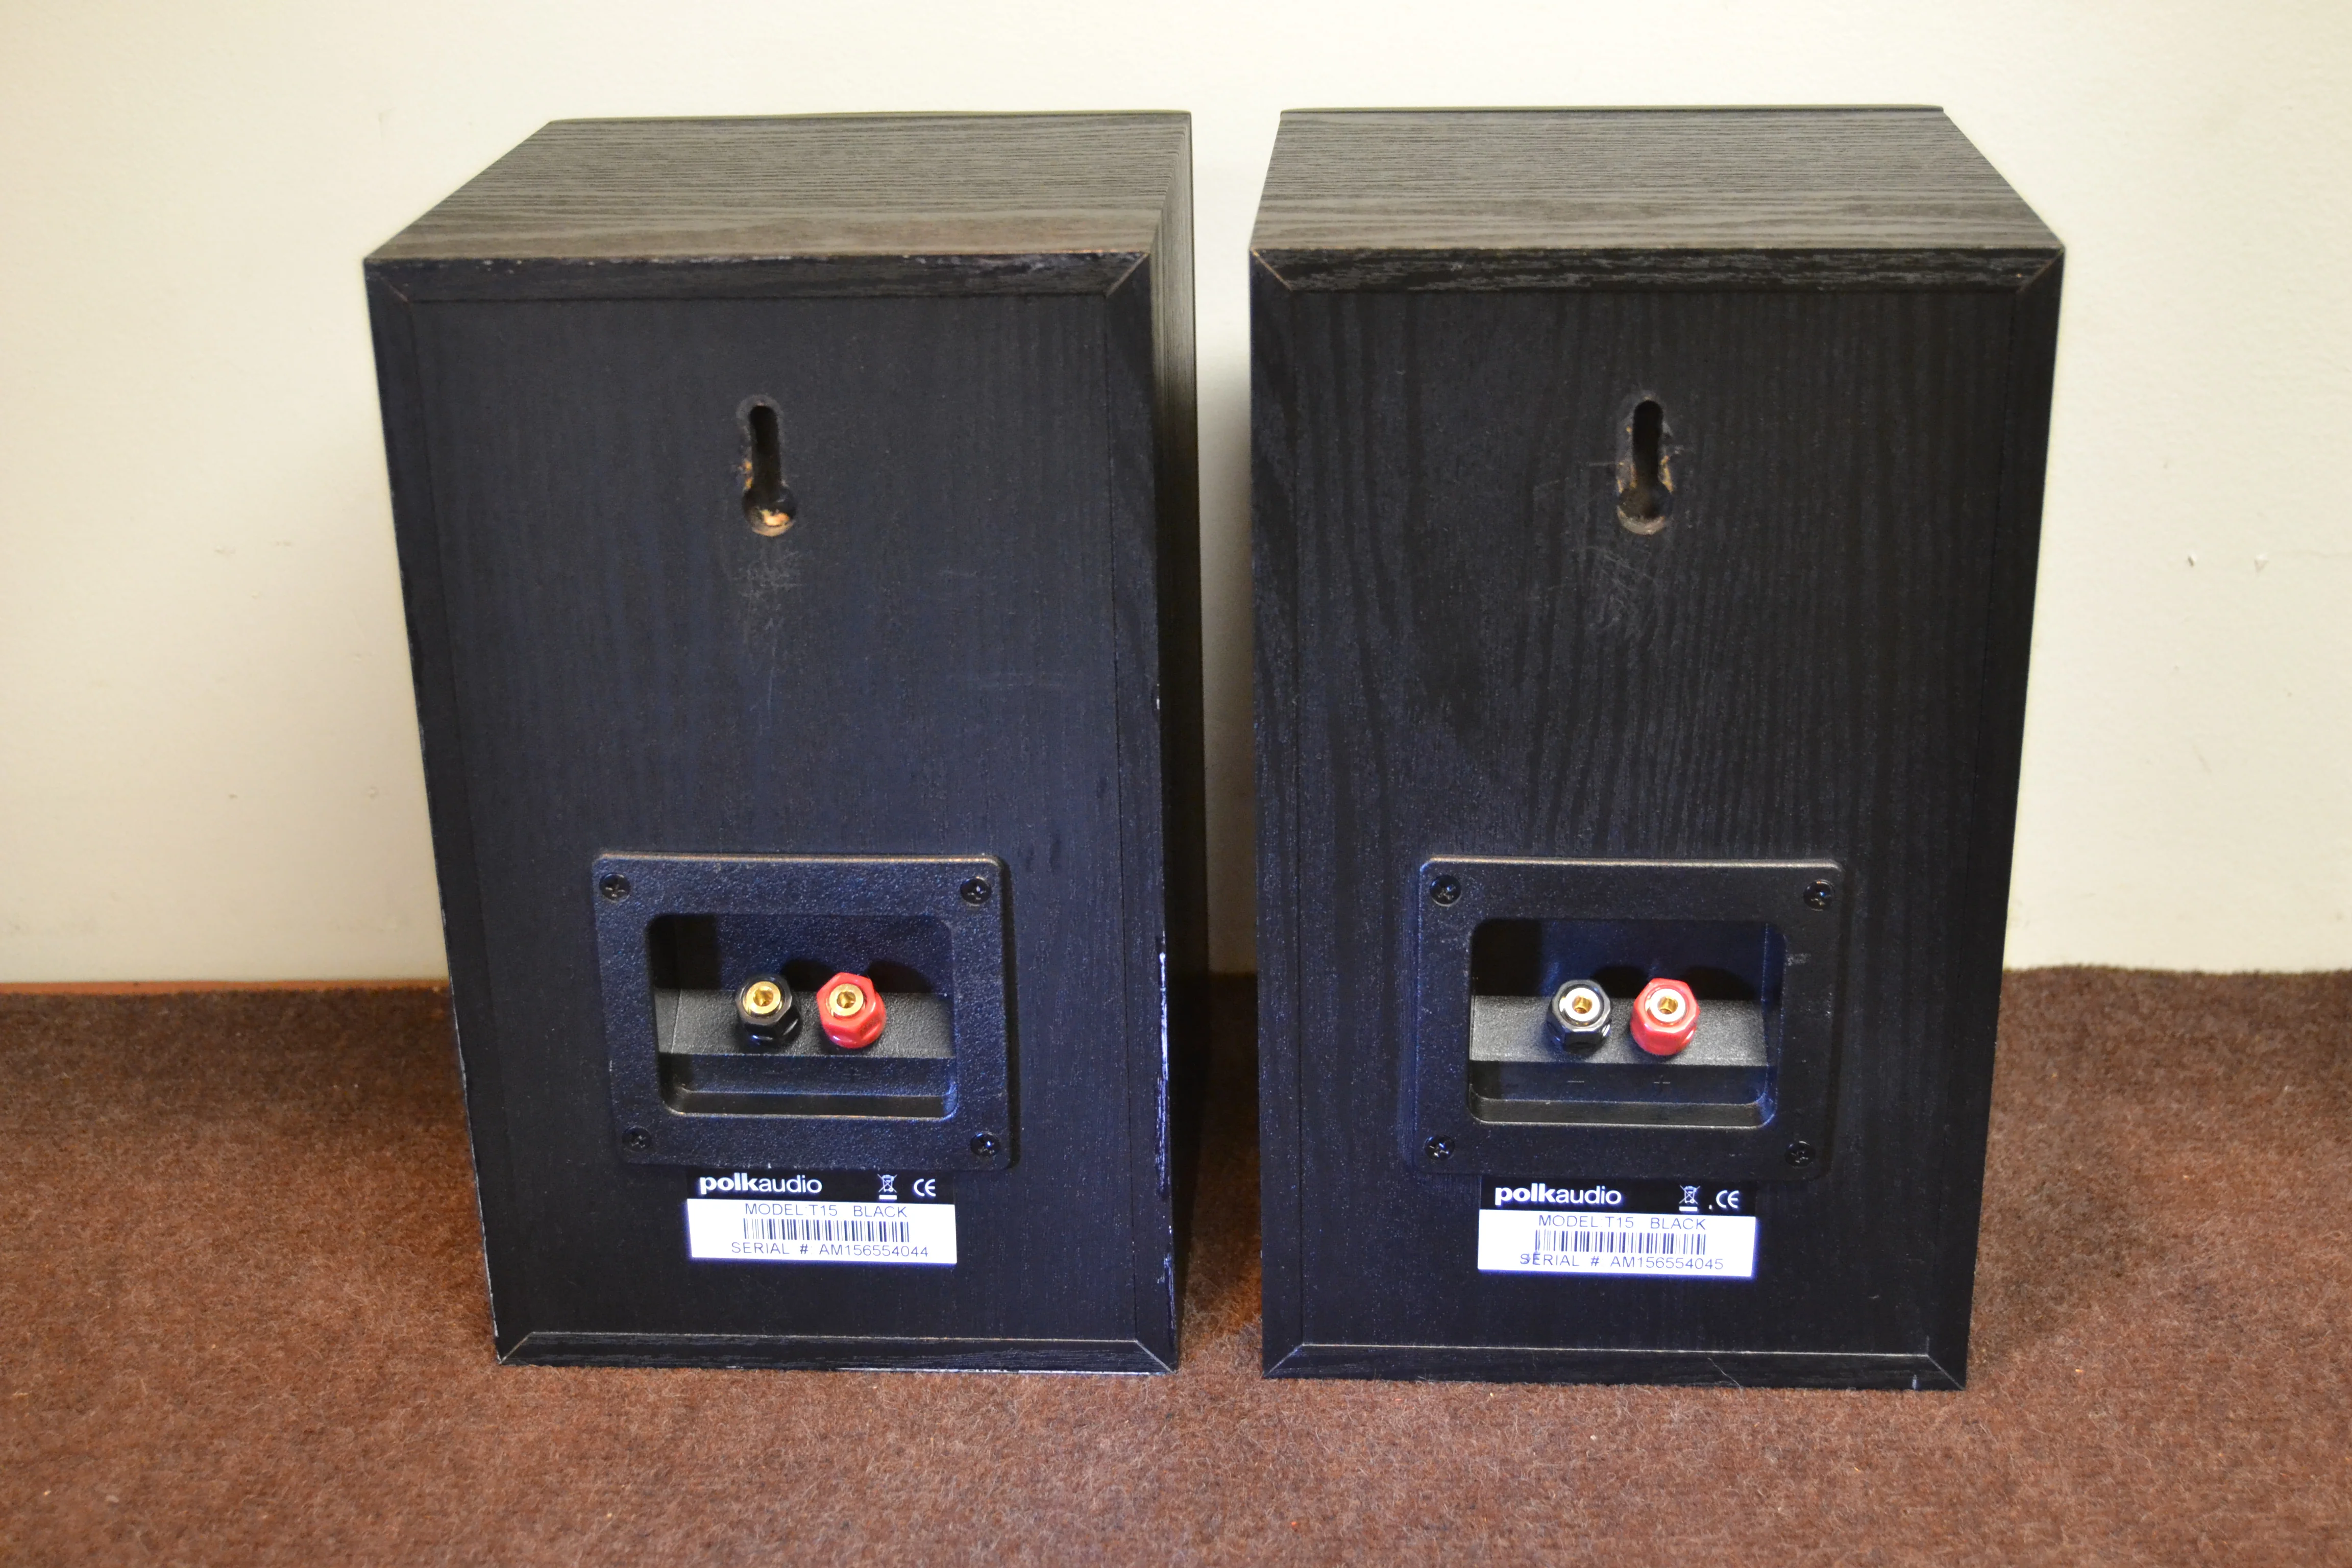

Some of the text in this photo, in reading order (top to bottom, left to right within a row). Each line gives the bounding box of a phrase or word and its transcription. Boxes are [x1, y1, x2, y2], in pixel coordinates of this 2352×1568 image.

[698, 1172, 822, 1195] polkaudio
[913, 1179, 936, 1197] CE
[1495, 1183, 1622, 1206] polkaudio
[1716, 1190, 1739, 1209] CE
[853, 1205, 907, 1218] BLACK
[1650, 1217, 1706, 1230] BLACK
[731, 1242, 790, 1255] SERIAL
[819, 1244, 928, 1257] AM156554044
[1520, 1254, 1579, 1266] SERIAL
[1610, 1256, 1723, 1270] AM156554045
